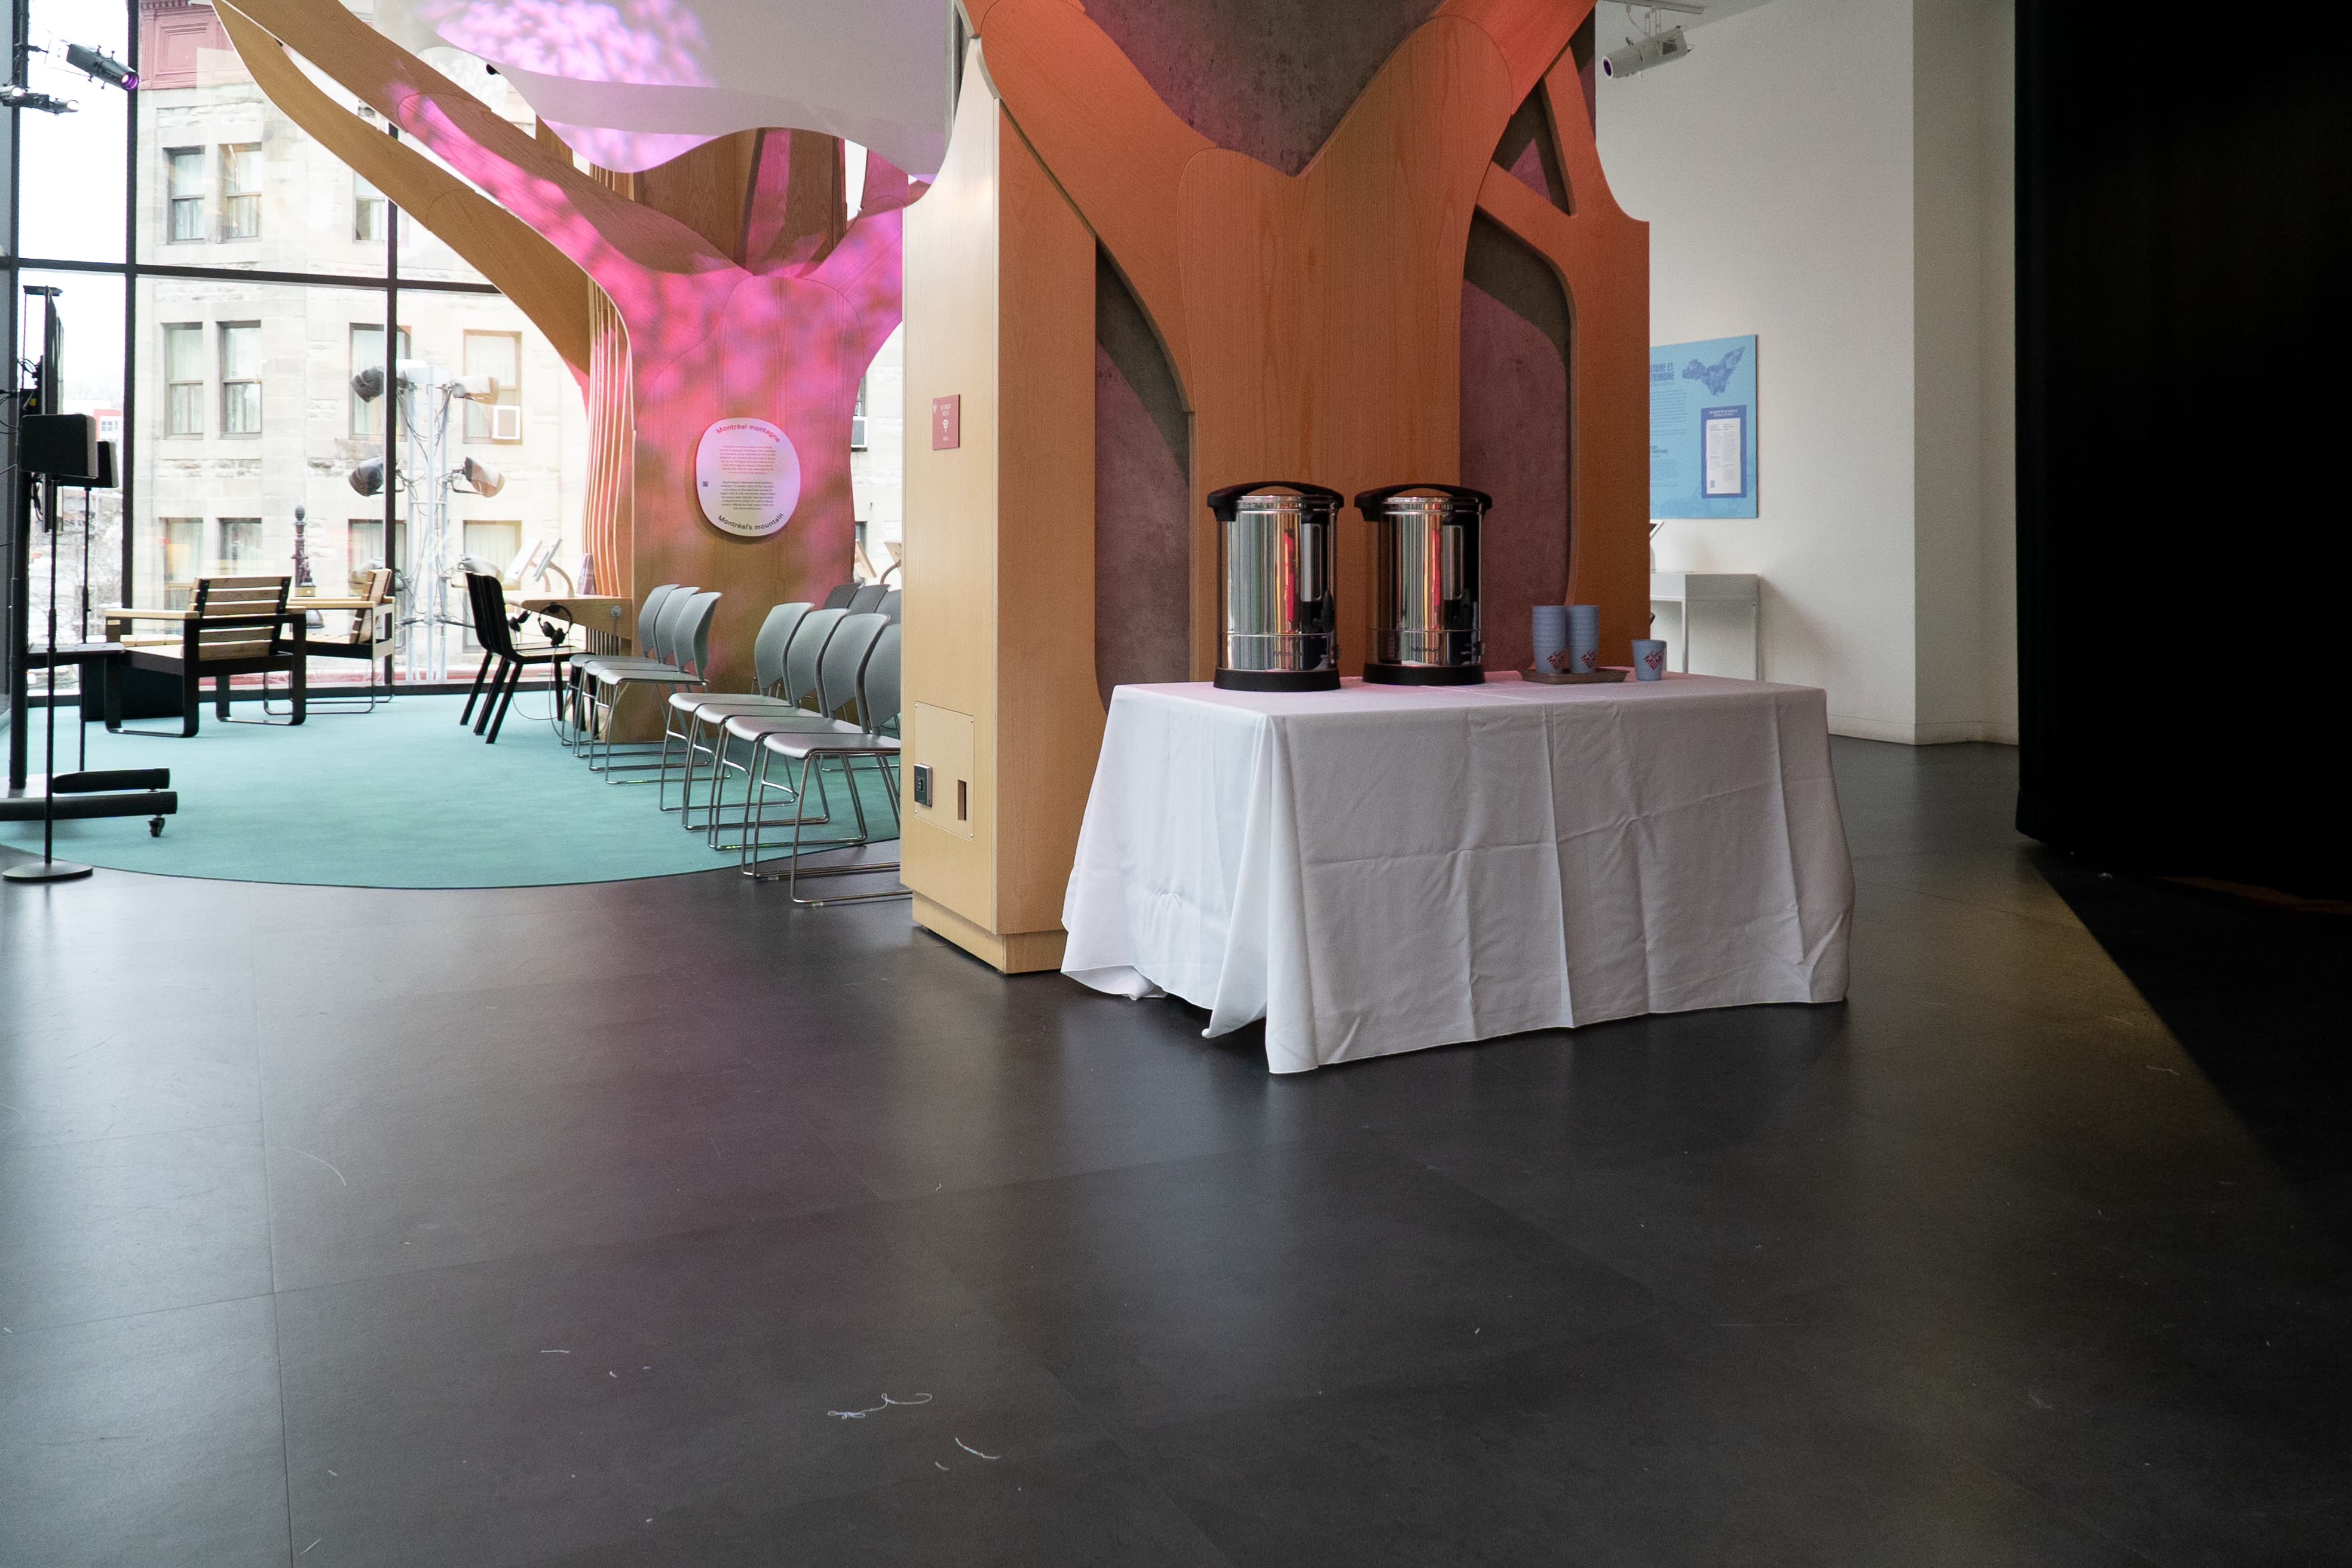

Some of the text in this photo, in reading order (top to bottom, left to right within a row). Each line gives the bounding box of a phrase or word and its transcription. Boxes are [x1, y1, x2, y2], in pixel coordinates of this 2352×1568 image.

[716, 424, 780, 443] Montréal montagne
[718, 513, 784, 530] Montréal's mountain
